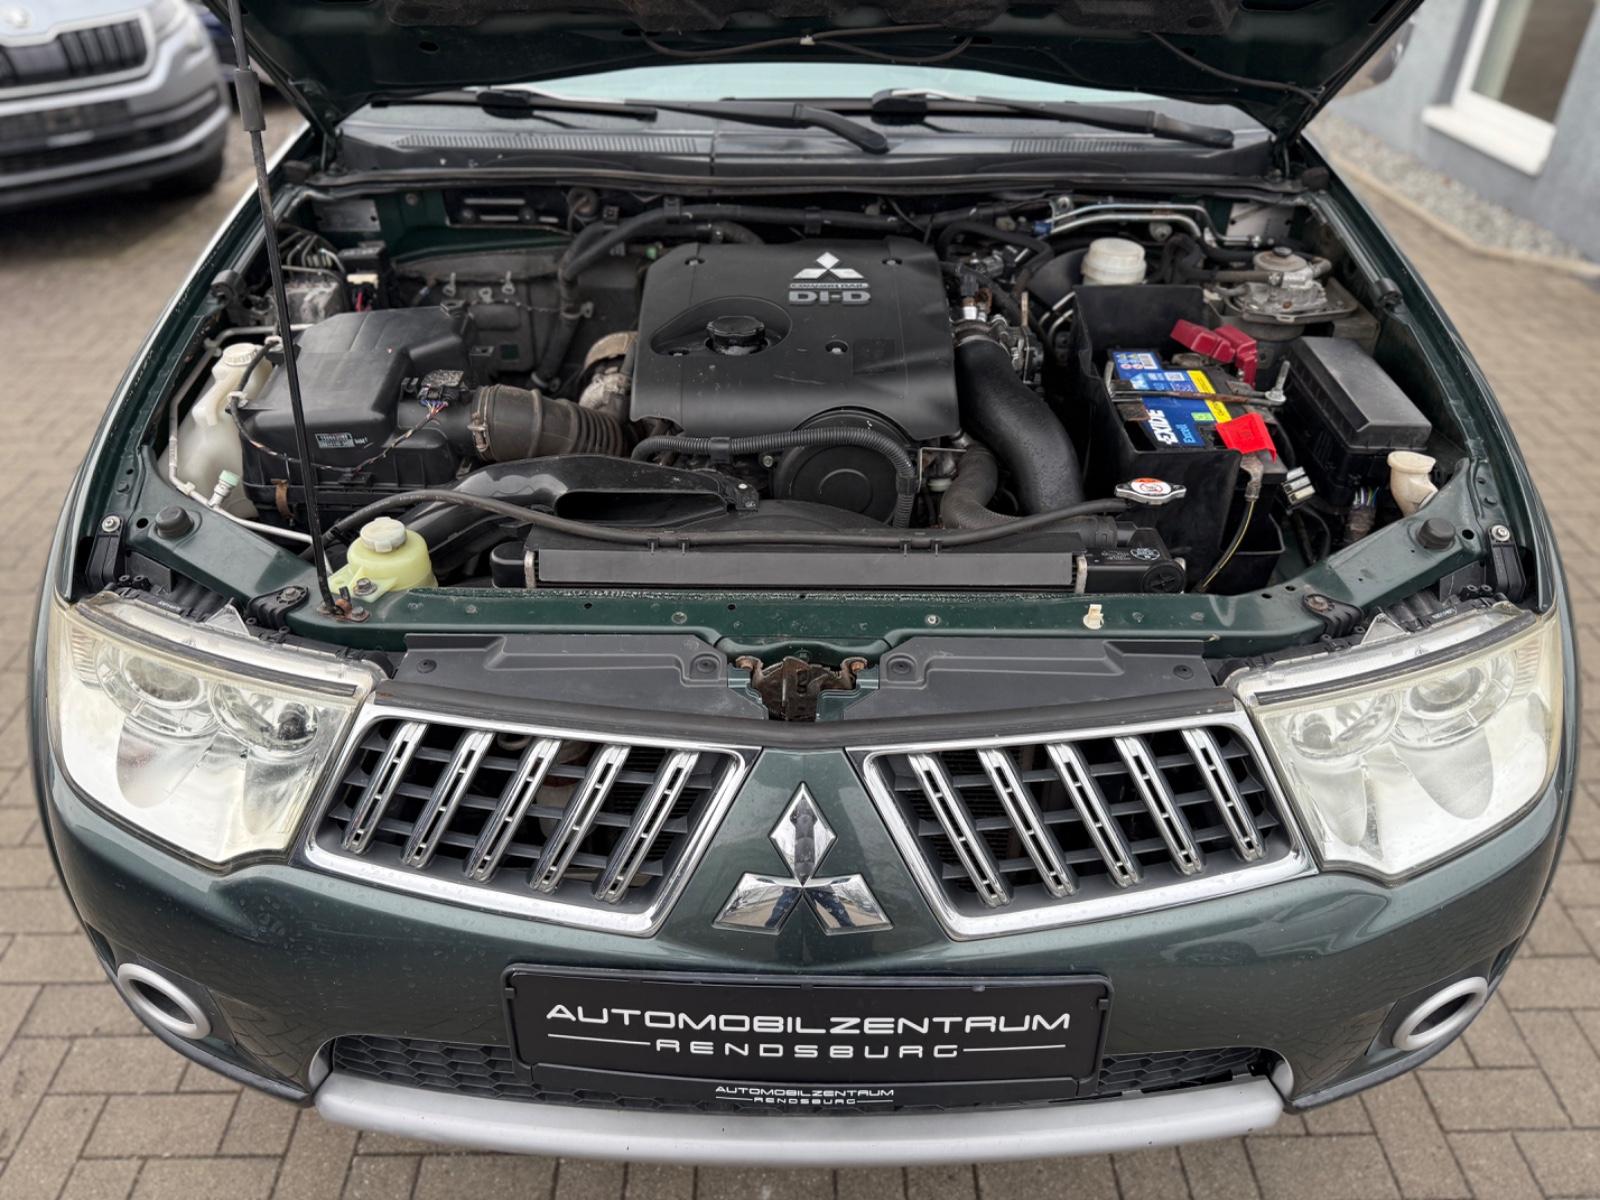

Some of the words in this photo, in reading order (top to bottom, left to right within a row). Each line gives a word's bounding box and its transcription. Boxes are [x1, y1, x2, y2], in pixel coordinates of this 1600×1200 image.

[788, 291, 871, 305] DI-D
[1146, 409, 1179, 445] EXIDE
[546, 1004, 1070, 1034] AUTOMOBILZENTRUM
[656, 1039, 958, 1059] RENDSBURG
[715, 1085, 895, 1097] AUTOMOBILZENTRUM
[753, 1097, 856, 1105] RENDSBURG
